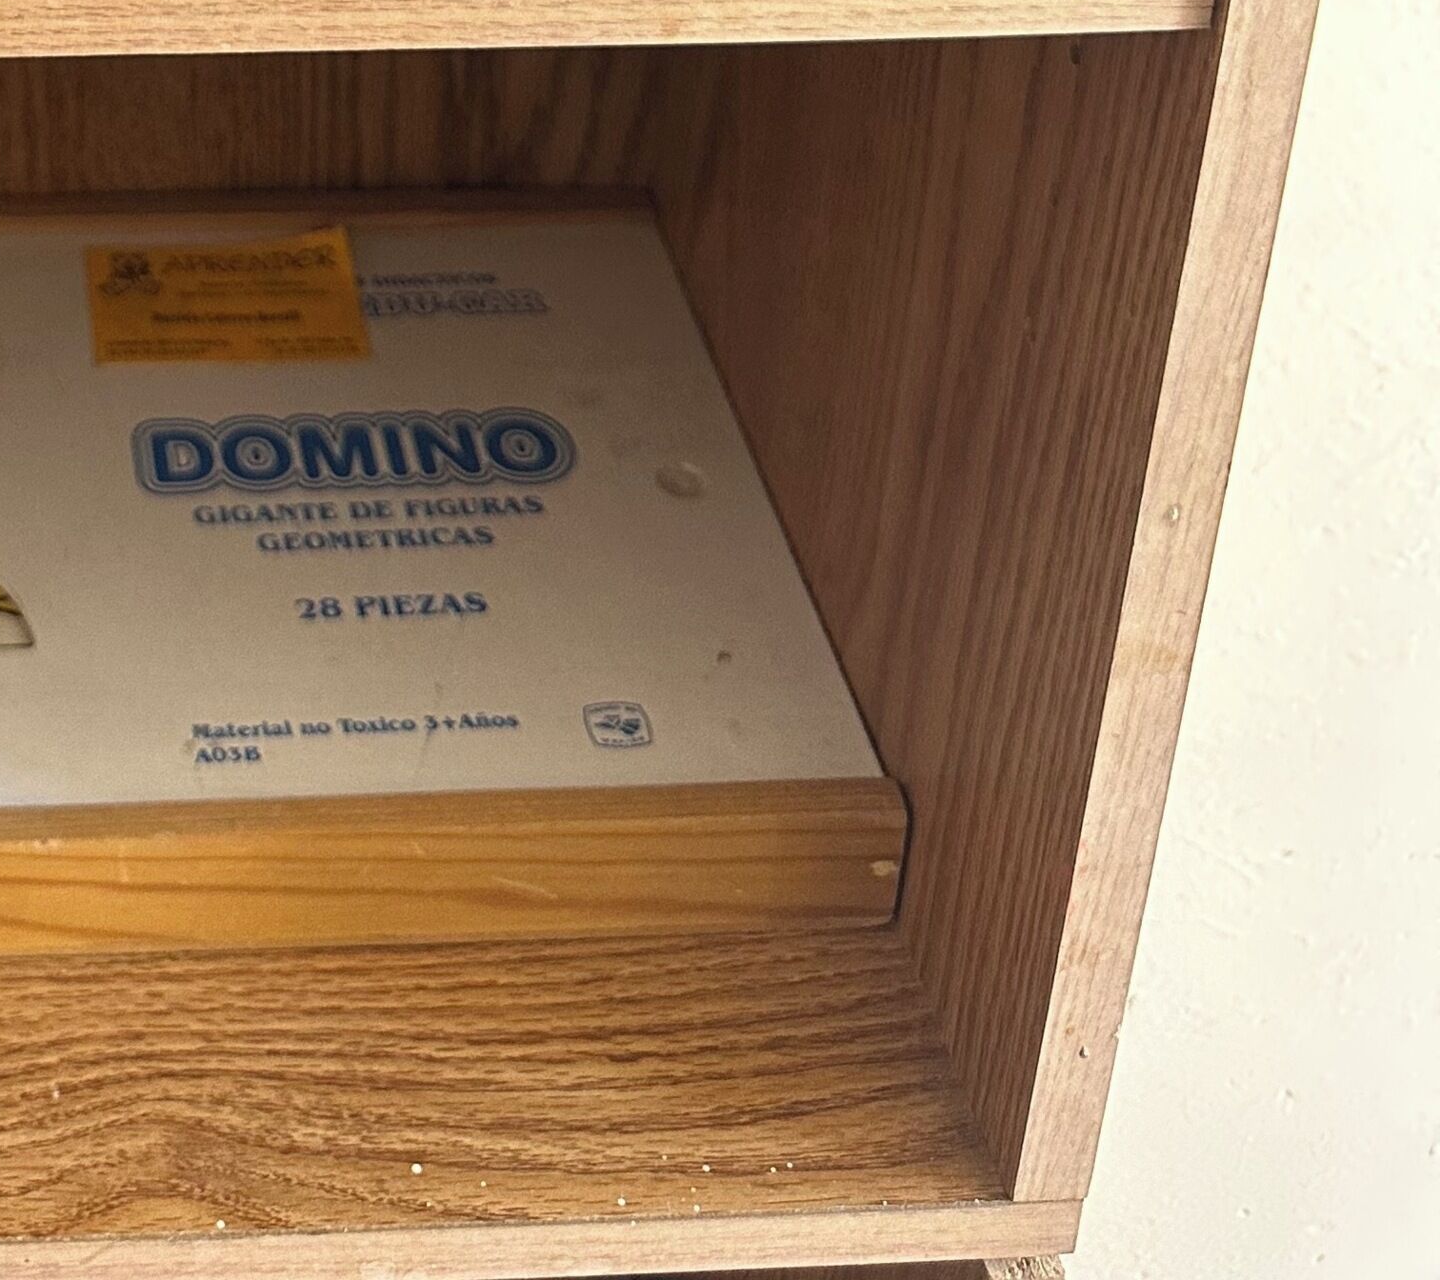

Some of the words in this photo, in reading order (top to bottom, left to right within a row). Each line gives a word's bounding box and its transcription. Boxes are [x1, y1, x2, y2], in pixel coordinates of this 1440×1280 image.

[138, 410, 572, 490] DOMINO
[193, 501, 337, 525] GIGANTE
[348, 498, 392, 521] DE
[404, 494, 544, 518] FIGURAS
[255, 526, 495, 552] GEOMETRICAS
[294, 597, 341, 620] 28
[354, 591, 488, 618] PIEZAS
[192, 720, 293, 739] Material
[299, 719, 330, 735] no
[336, 715, 416, 734] Toxico
